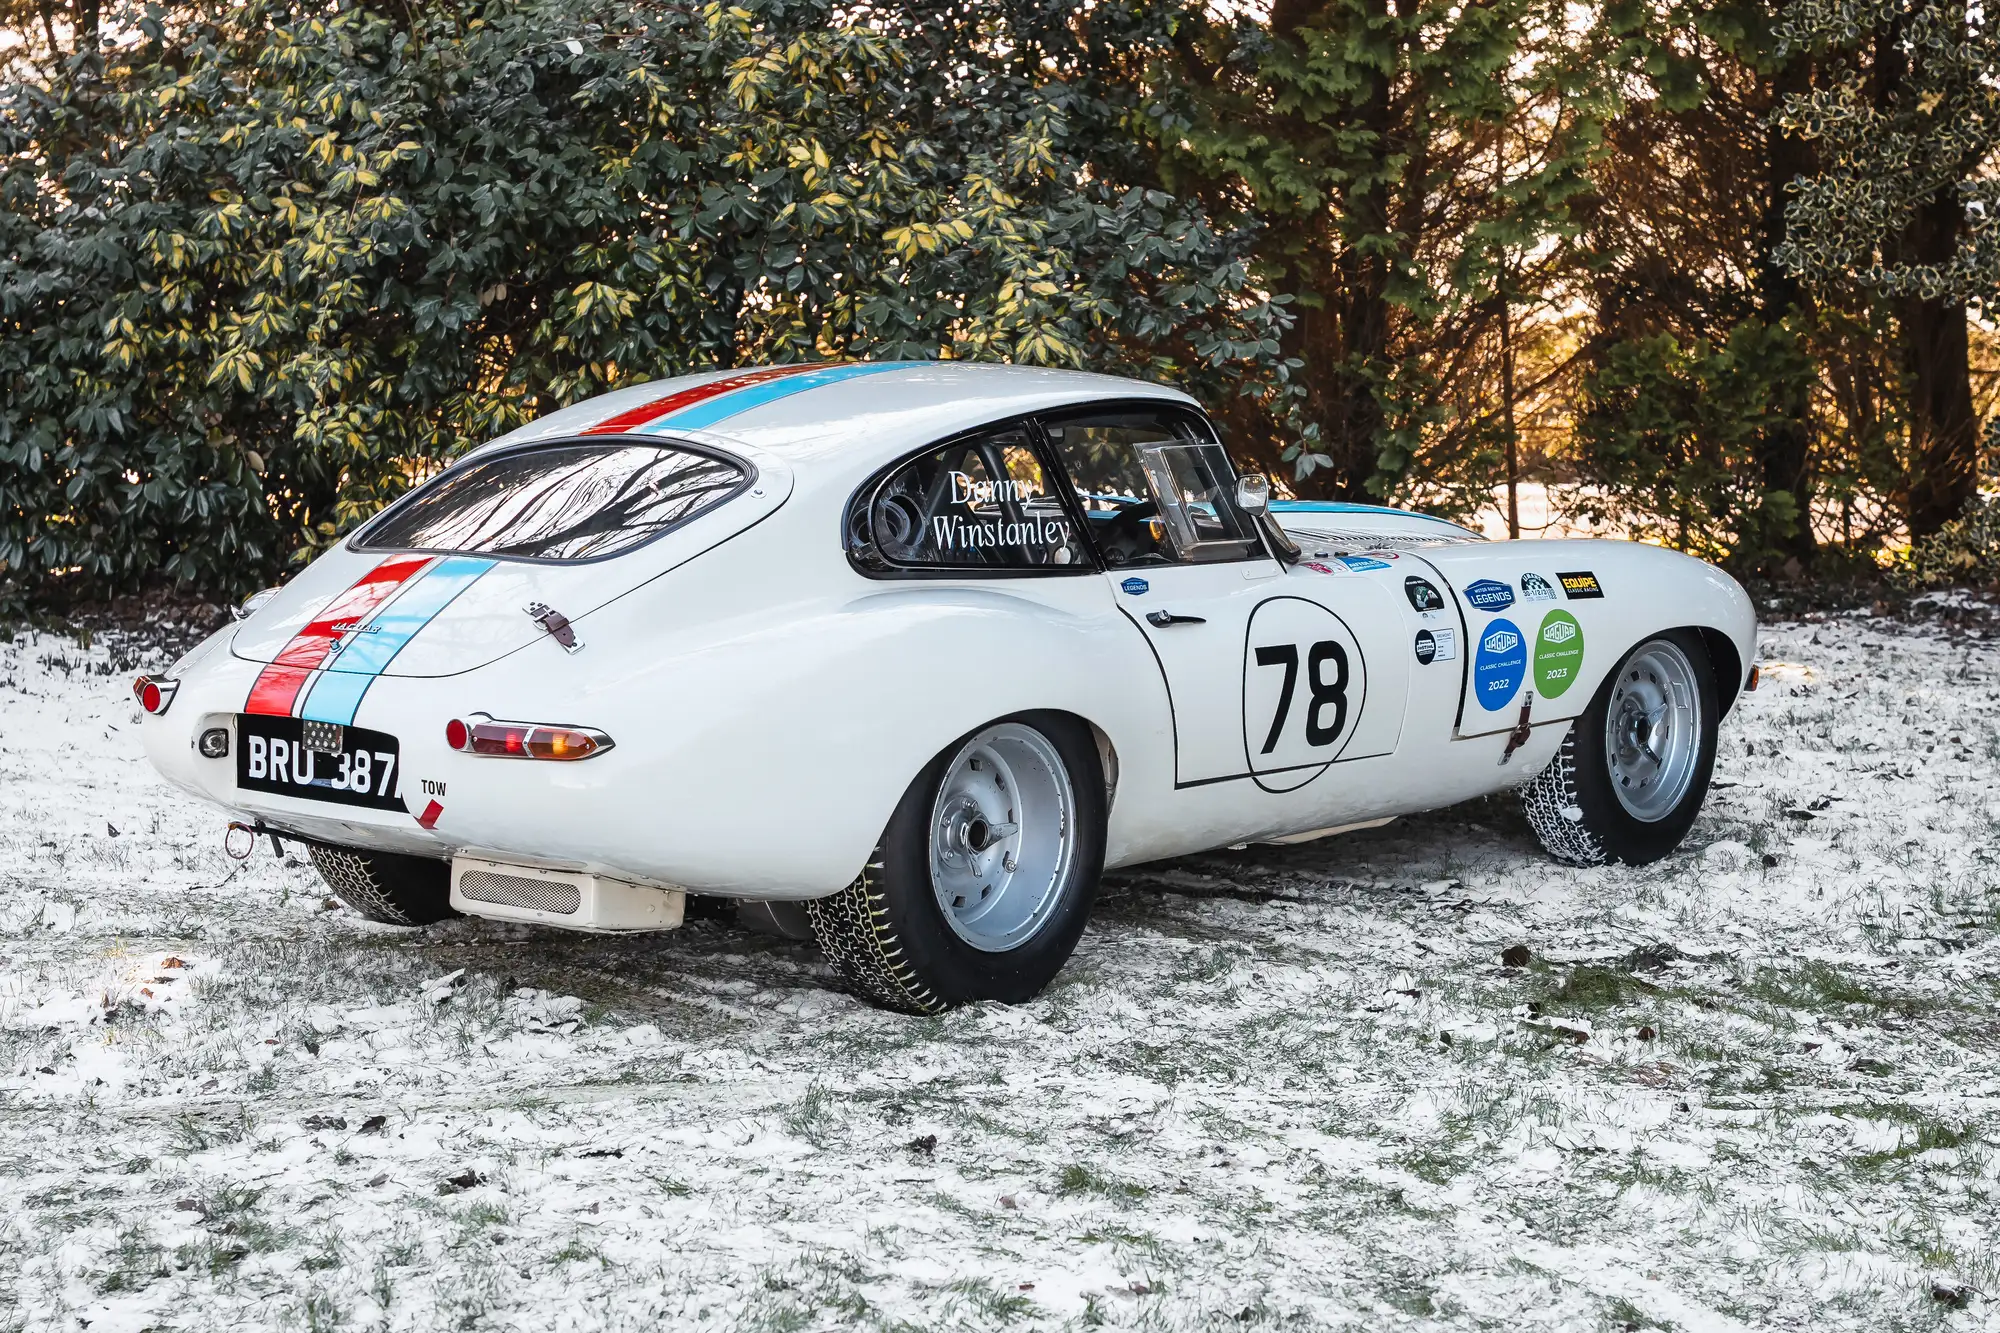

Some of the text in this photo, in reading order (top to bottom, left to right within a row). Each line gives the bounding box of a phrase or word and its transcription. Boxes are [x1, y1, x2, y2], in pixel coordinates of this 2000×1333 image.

[948, 471, 1033, 511] Danny
[933, 510, 1070, 551] Winstanley
[1562, 576, 1597, 588] EQUIPE
[1471, 591, 1512, 605] LEGENDS
[1545, 622, 1575, 641] JAGUAR
[1486, 633, 1517, 651] JAGUAR
[1539, 649, 1579, 660] CLASSIC CHALLENGE
[1480, 659, 1522, 671] CLASSIC CHALLENGE
[1546, 667, 1568, 680] 2023
[1488, 679, 1510, 691] 2022
[1254, 640, 1350, 755] 78
[247, 734, 315, 786] BRU
[421, 779, 447, 797] TOW
